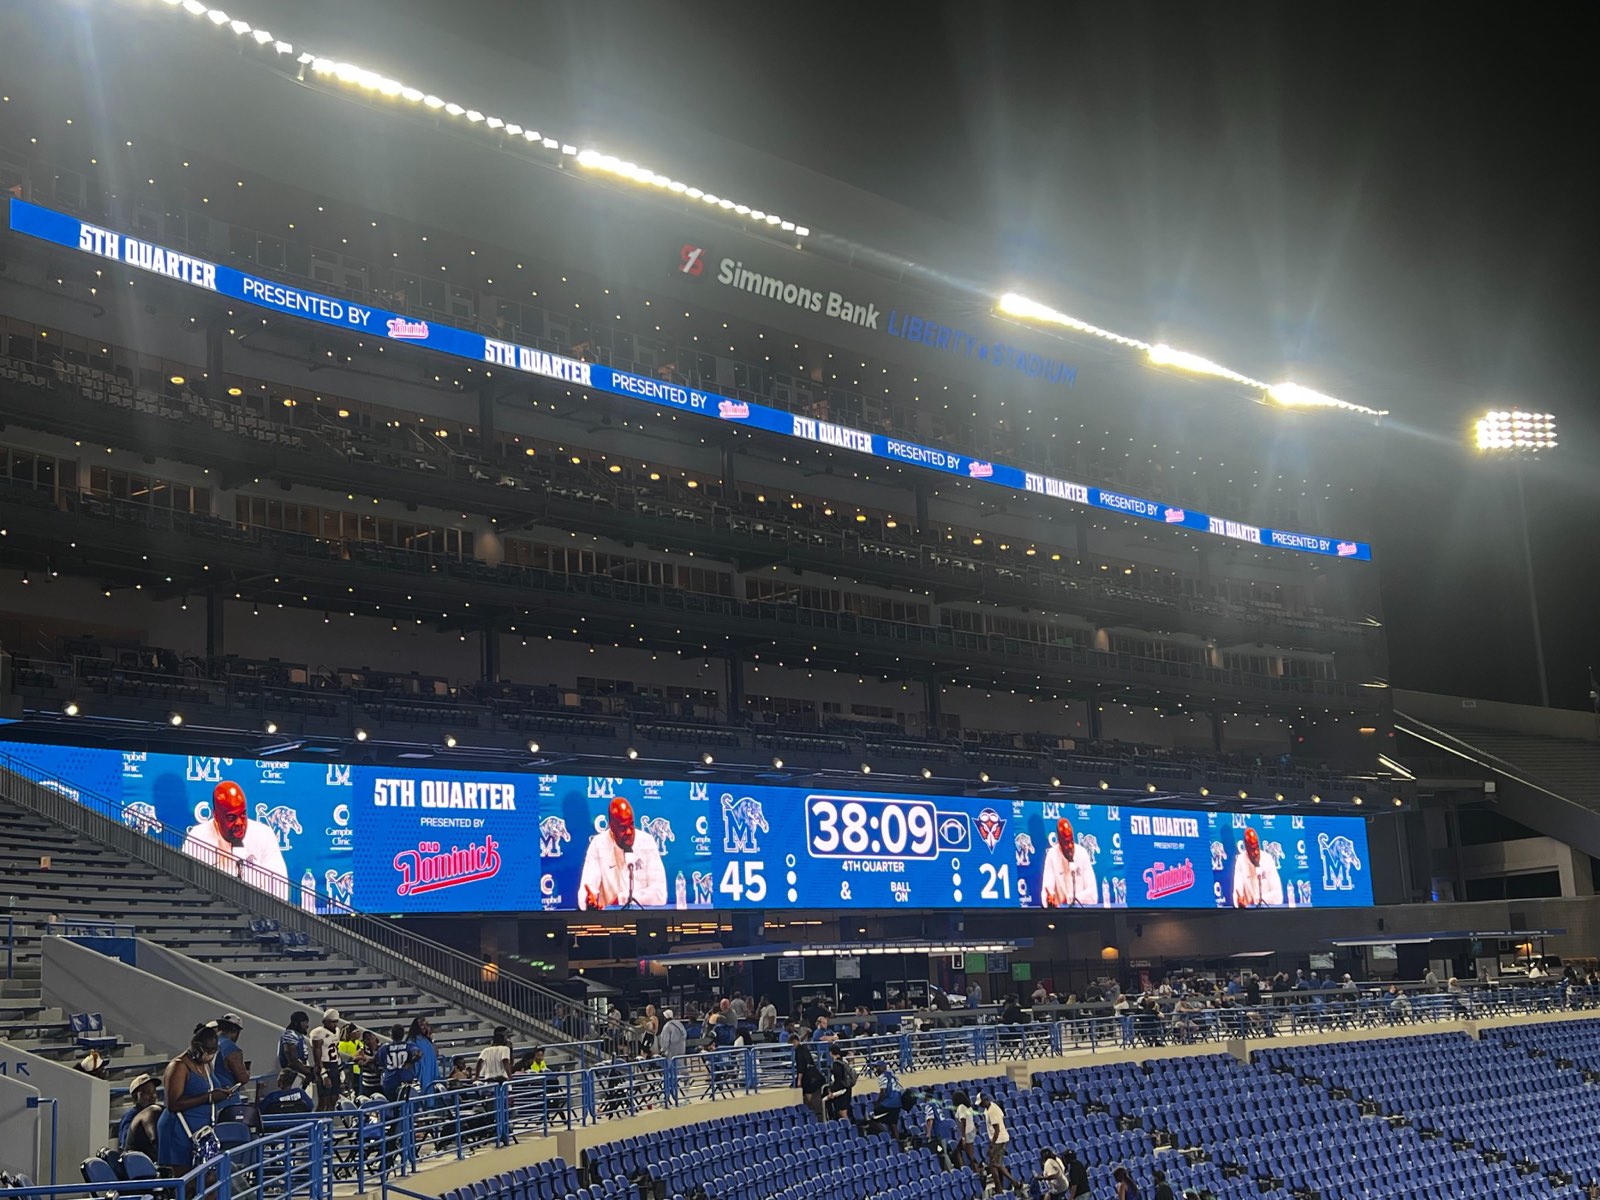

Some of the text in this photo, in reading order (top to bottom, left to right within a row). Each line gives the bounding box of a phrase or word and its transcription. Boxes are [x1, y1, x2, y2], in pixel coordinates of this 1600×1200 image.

[80, 223, 217, 290] 5TH QUARTER
[243, 277, 371, 326] PRESENTED BY
[717, 257, 1078, 389] Simmons Bank LIBERTY STADIUM
[484, 338, 592, 386] 5TH QUARTER
[612, 372, 708, 410] PRESENTED BY
[793, 416, 872, 454] 5TH QUARTER
[888, 442, 945, 467] PRESENTED
[948, 456, 960, 470] BY
[1025, 472, 1088, 504] 5TH QUARTER
[1100, 492, 1146, 514] PRESENTED
[1148, 504, 1158, 516] BY
[1210, 517, 1262, 544] 5TH QUARTER
[1272, 532, 1318, 549] PRESENTED
[1320, 540, 1330, 551] BY
[256, 759, 289, 770] Campbell
[262, 768, 282, 779] Clinic
[374, 778, 517, 810] 5TH QUARTER
[420, 817, 485, 828] PRESENTED BY
[811, 800, 933, 854] 38:09
[1130, 815, 1200, 838] 5TH QUARTER
[419, 842, 440, 852] OLD
[394, 834, 501, 896] Dominick
[842, 861, 904, 873] 4TH QUARTER
[720, 860, 767, 902] 45
[840, 880, 852, 900] &
[890, 881, 911, 892] BALL
[979, 863, 1010, 900] 21
[895, 892, 908, 902] ON
